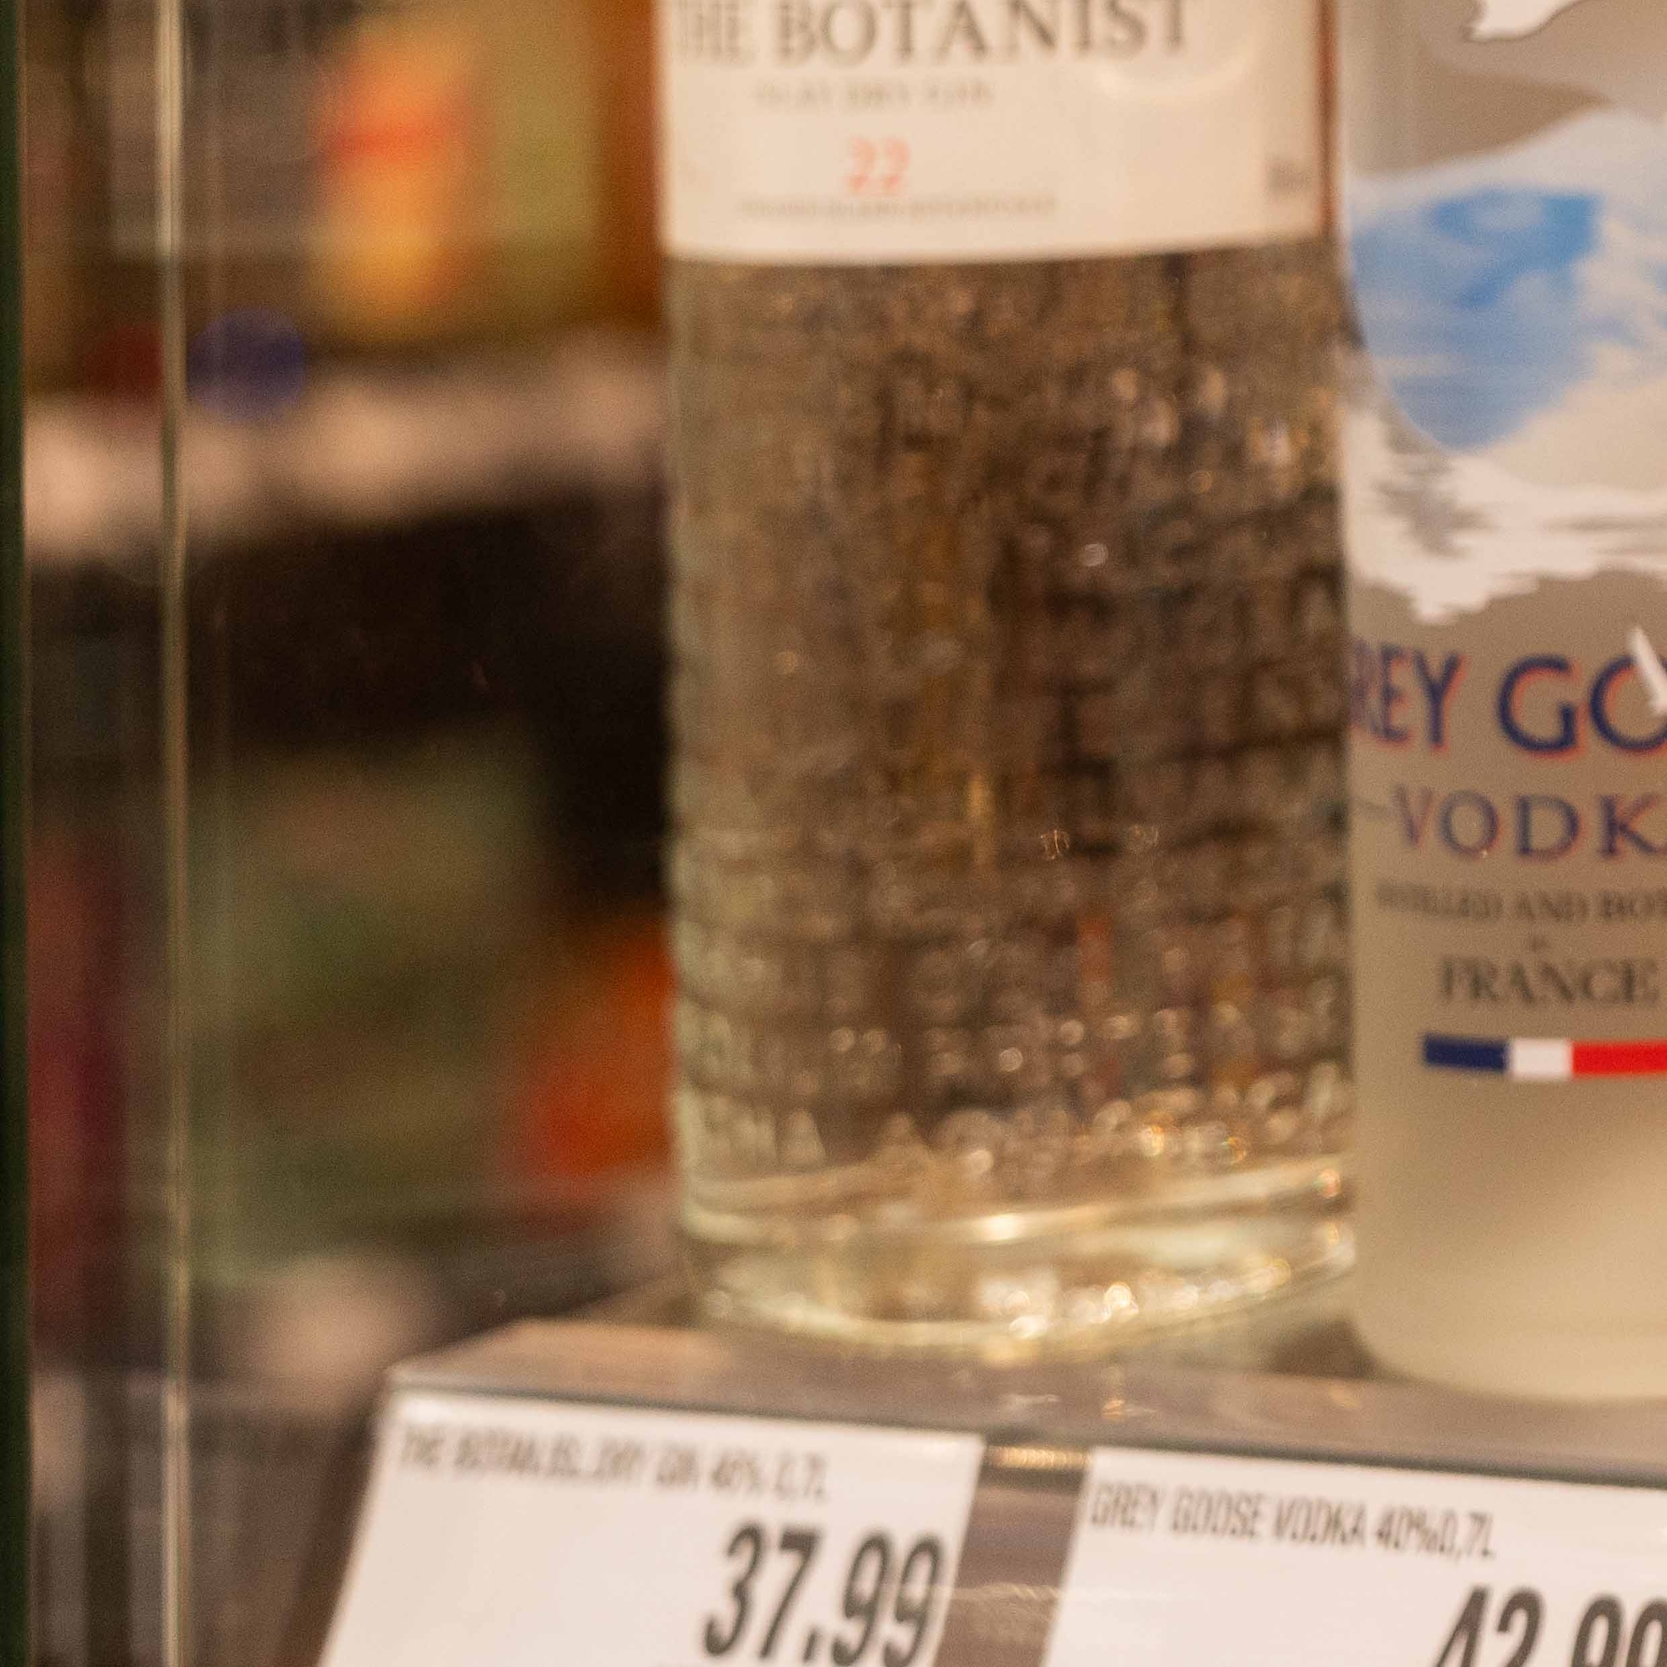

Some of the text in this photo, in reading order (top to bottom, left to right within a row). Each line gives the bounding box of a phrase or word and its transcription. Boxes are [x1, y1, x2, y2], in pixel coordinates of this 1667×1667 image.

[1438, 954, 1662, 1006] FRANCE
[1089, 1483, 1161, 1531] GREY
[1171, 1488, 1266, 1538] GOOSE
[1273, 1496, 1367, 1546] VODKA
[703, 1521, 946, 1667] 37.99
